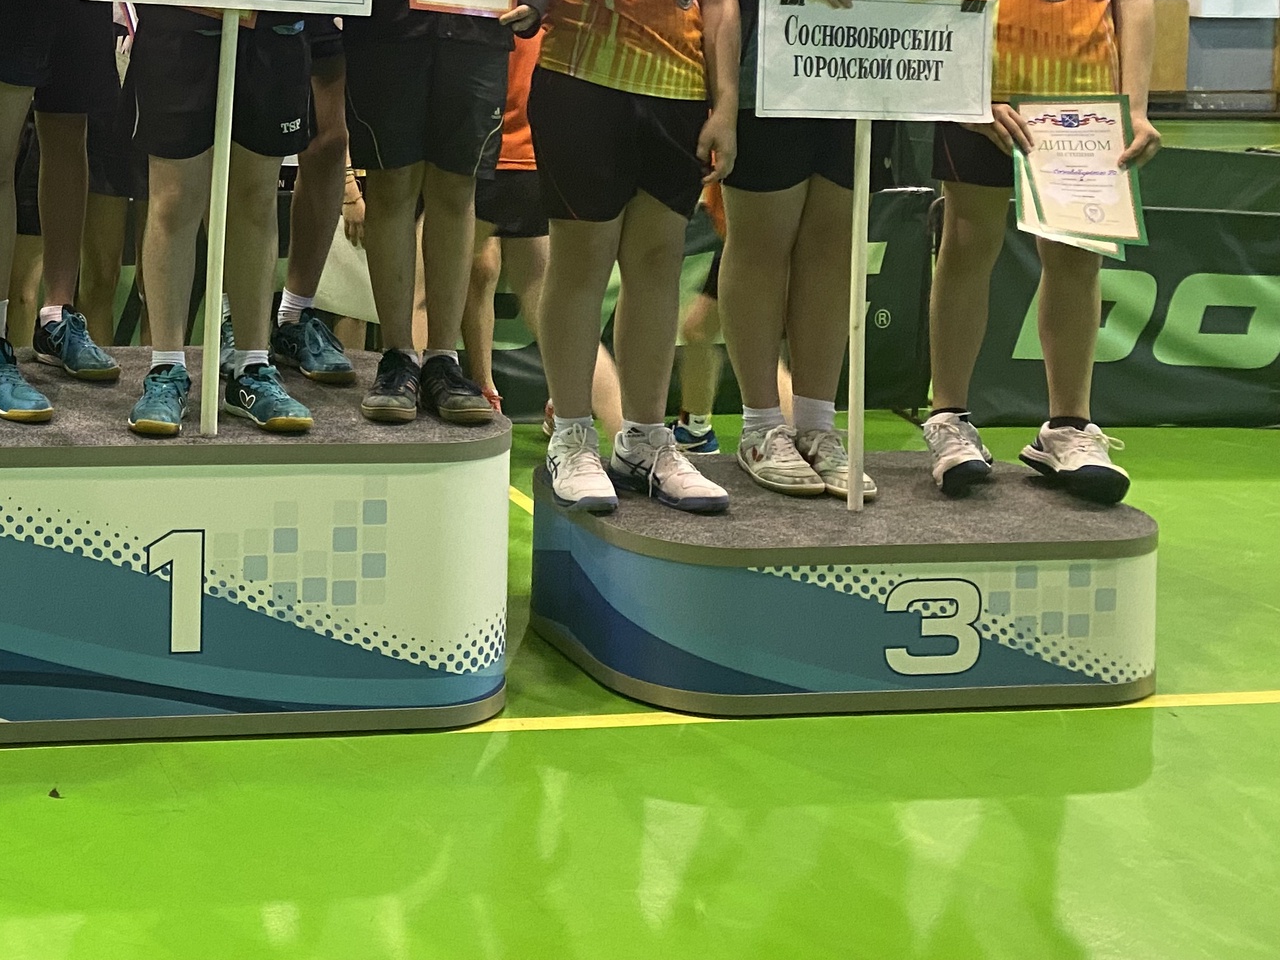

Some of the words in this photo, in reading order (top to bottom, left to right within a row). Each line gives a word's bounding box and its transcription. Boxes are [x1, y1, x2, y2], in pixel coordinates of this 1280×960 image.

[793, 53, 893, 81] ГОРОДСКОЙ
[896, 58, 944, 82] ОКРУГ
[1038, 139, 1111, 151] ДИПЛОМ
[146, 529, 205, 654] 1
[884, 578, 982, 676] 3
